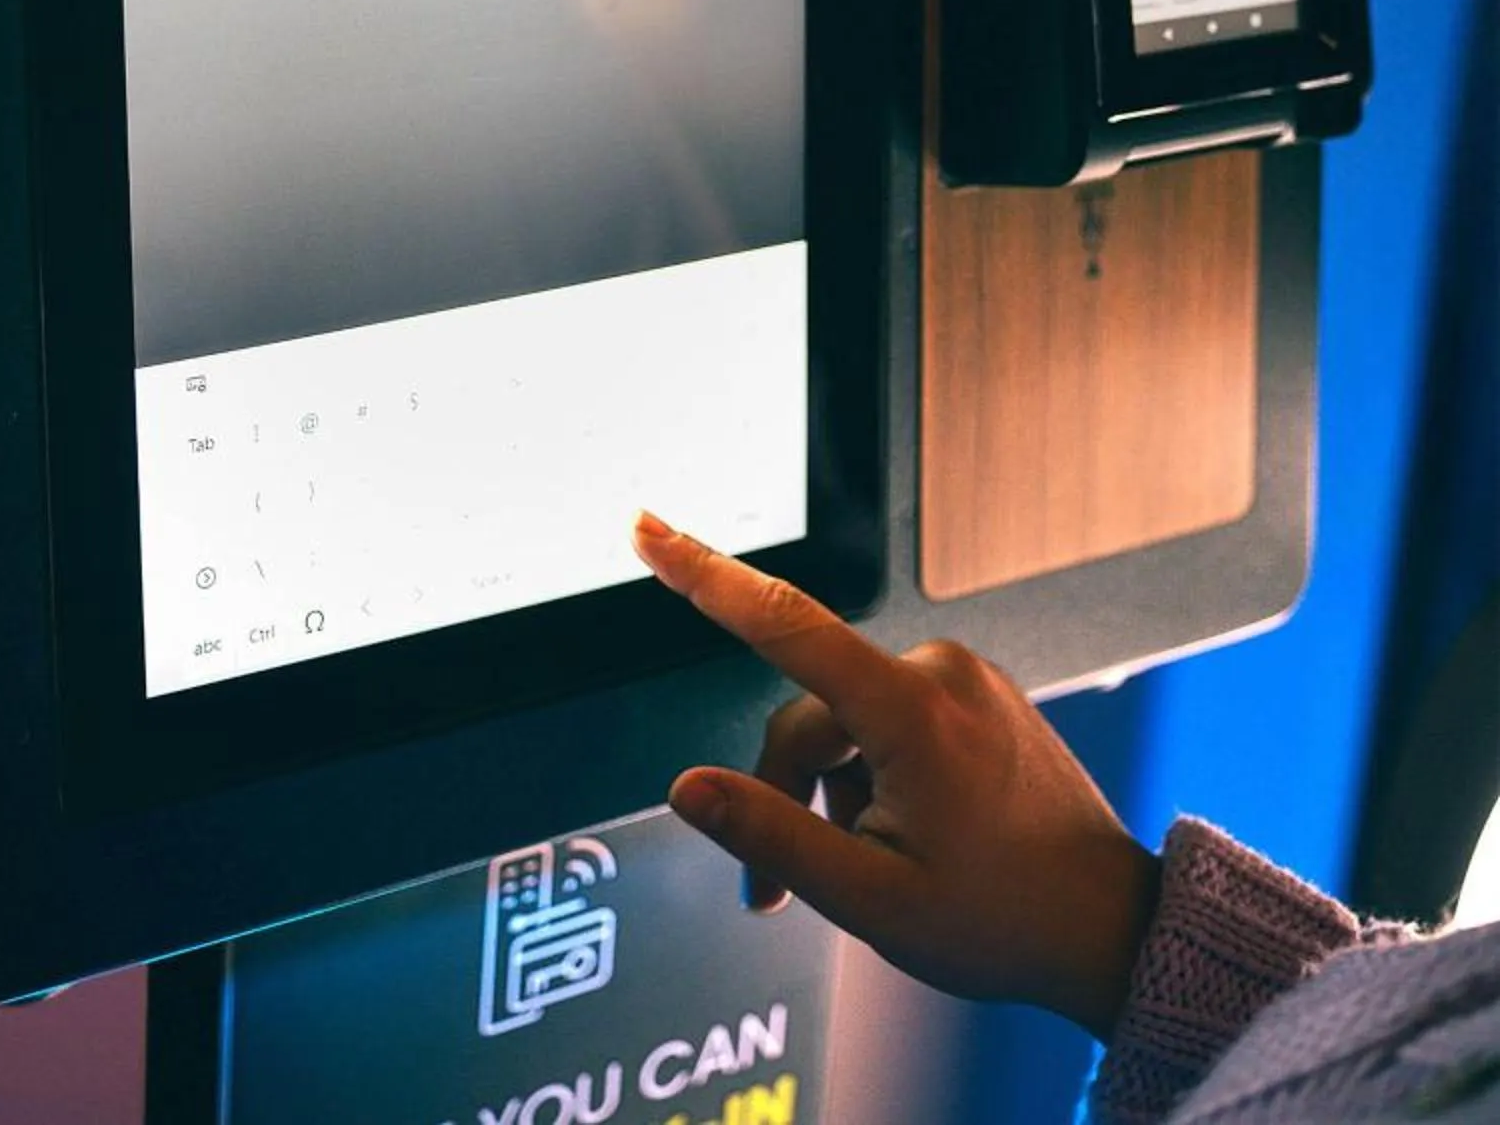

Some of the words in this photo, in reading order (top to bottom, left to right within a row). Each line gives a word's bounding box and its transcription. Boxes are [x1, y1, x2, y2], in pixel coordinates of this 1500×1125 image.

[188, 435, 216, 454] Tab
[193, 638, 223, 657] abc
[249, 625, 277, 645] Ctrl
[638, 1001, 790, 1101] CAN
